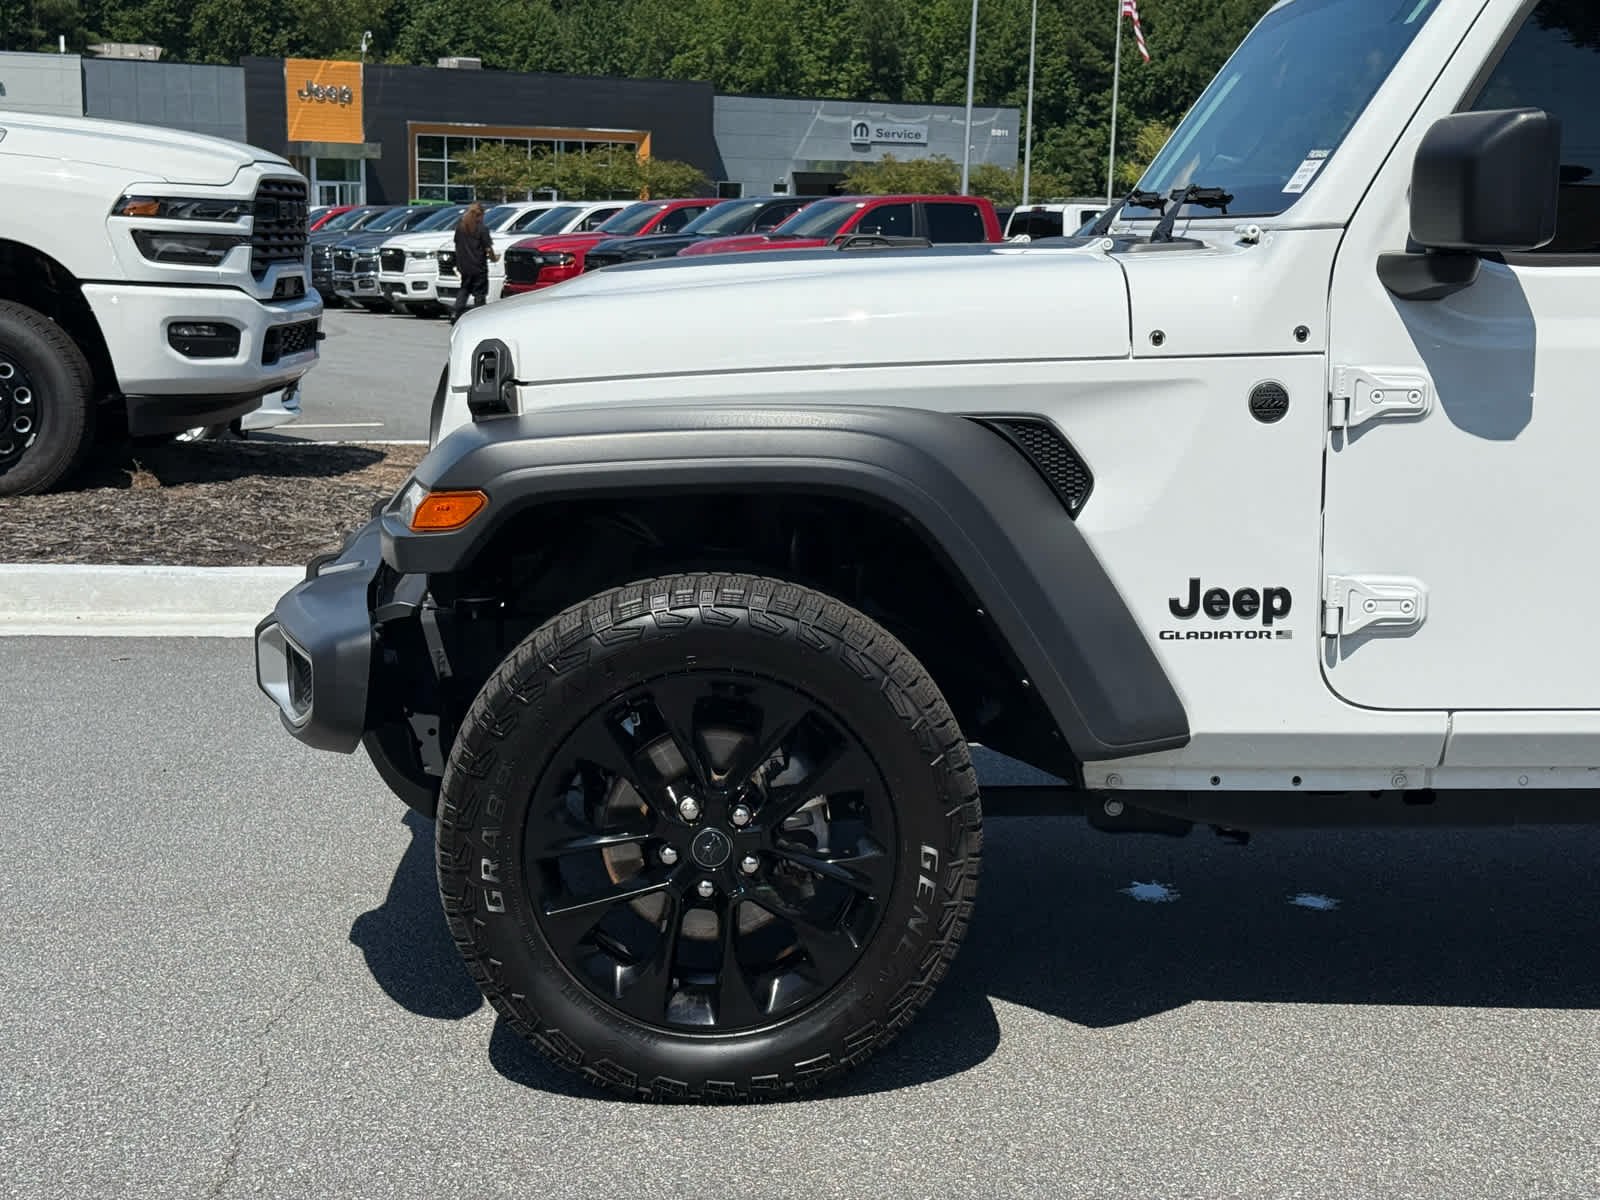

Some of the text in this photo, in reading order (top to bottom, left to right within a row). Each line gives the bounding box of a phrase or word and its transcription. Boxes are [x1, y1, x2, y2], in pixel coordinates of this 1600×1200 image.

[297, 80, 353, 108] Jeep
[875, 128, 922, 140] Service
[1168, 577, 1292, 627] Jeep
[1159, 630, 1272, 640] GLADIATOR
